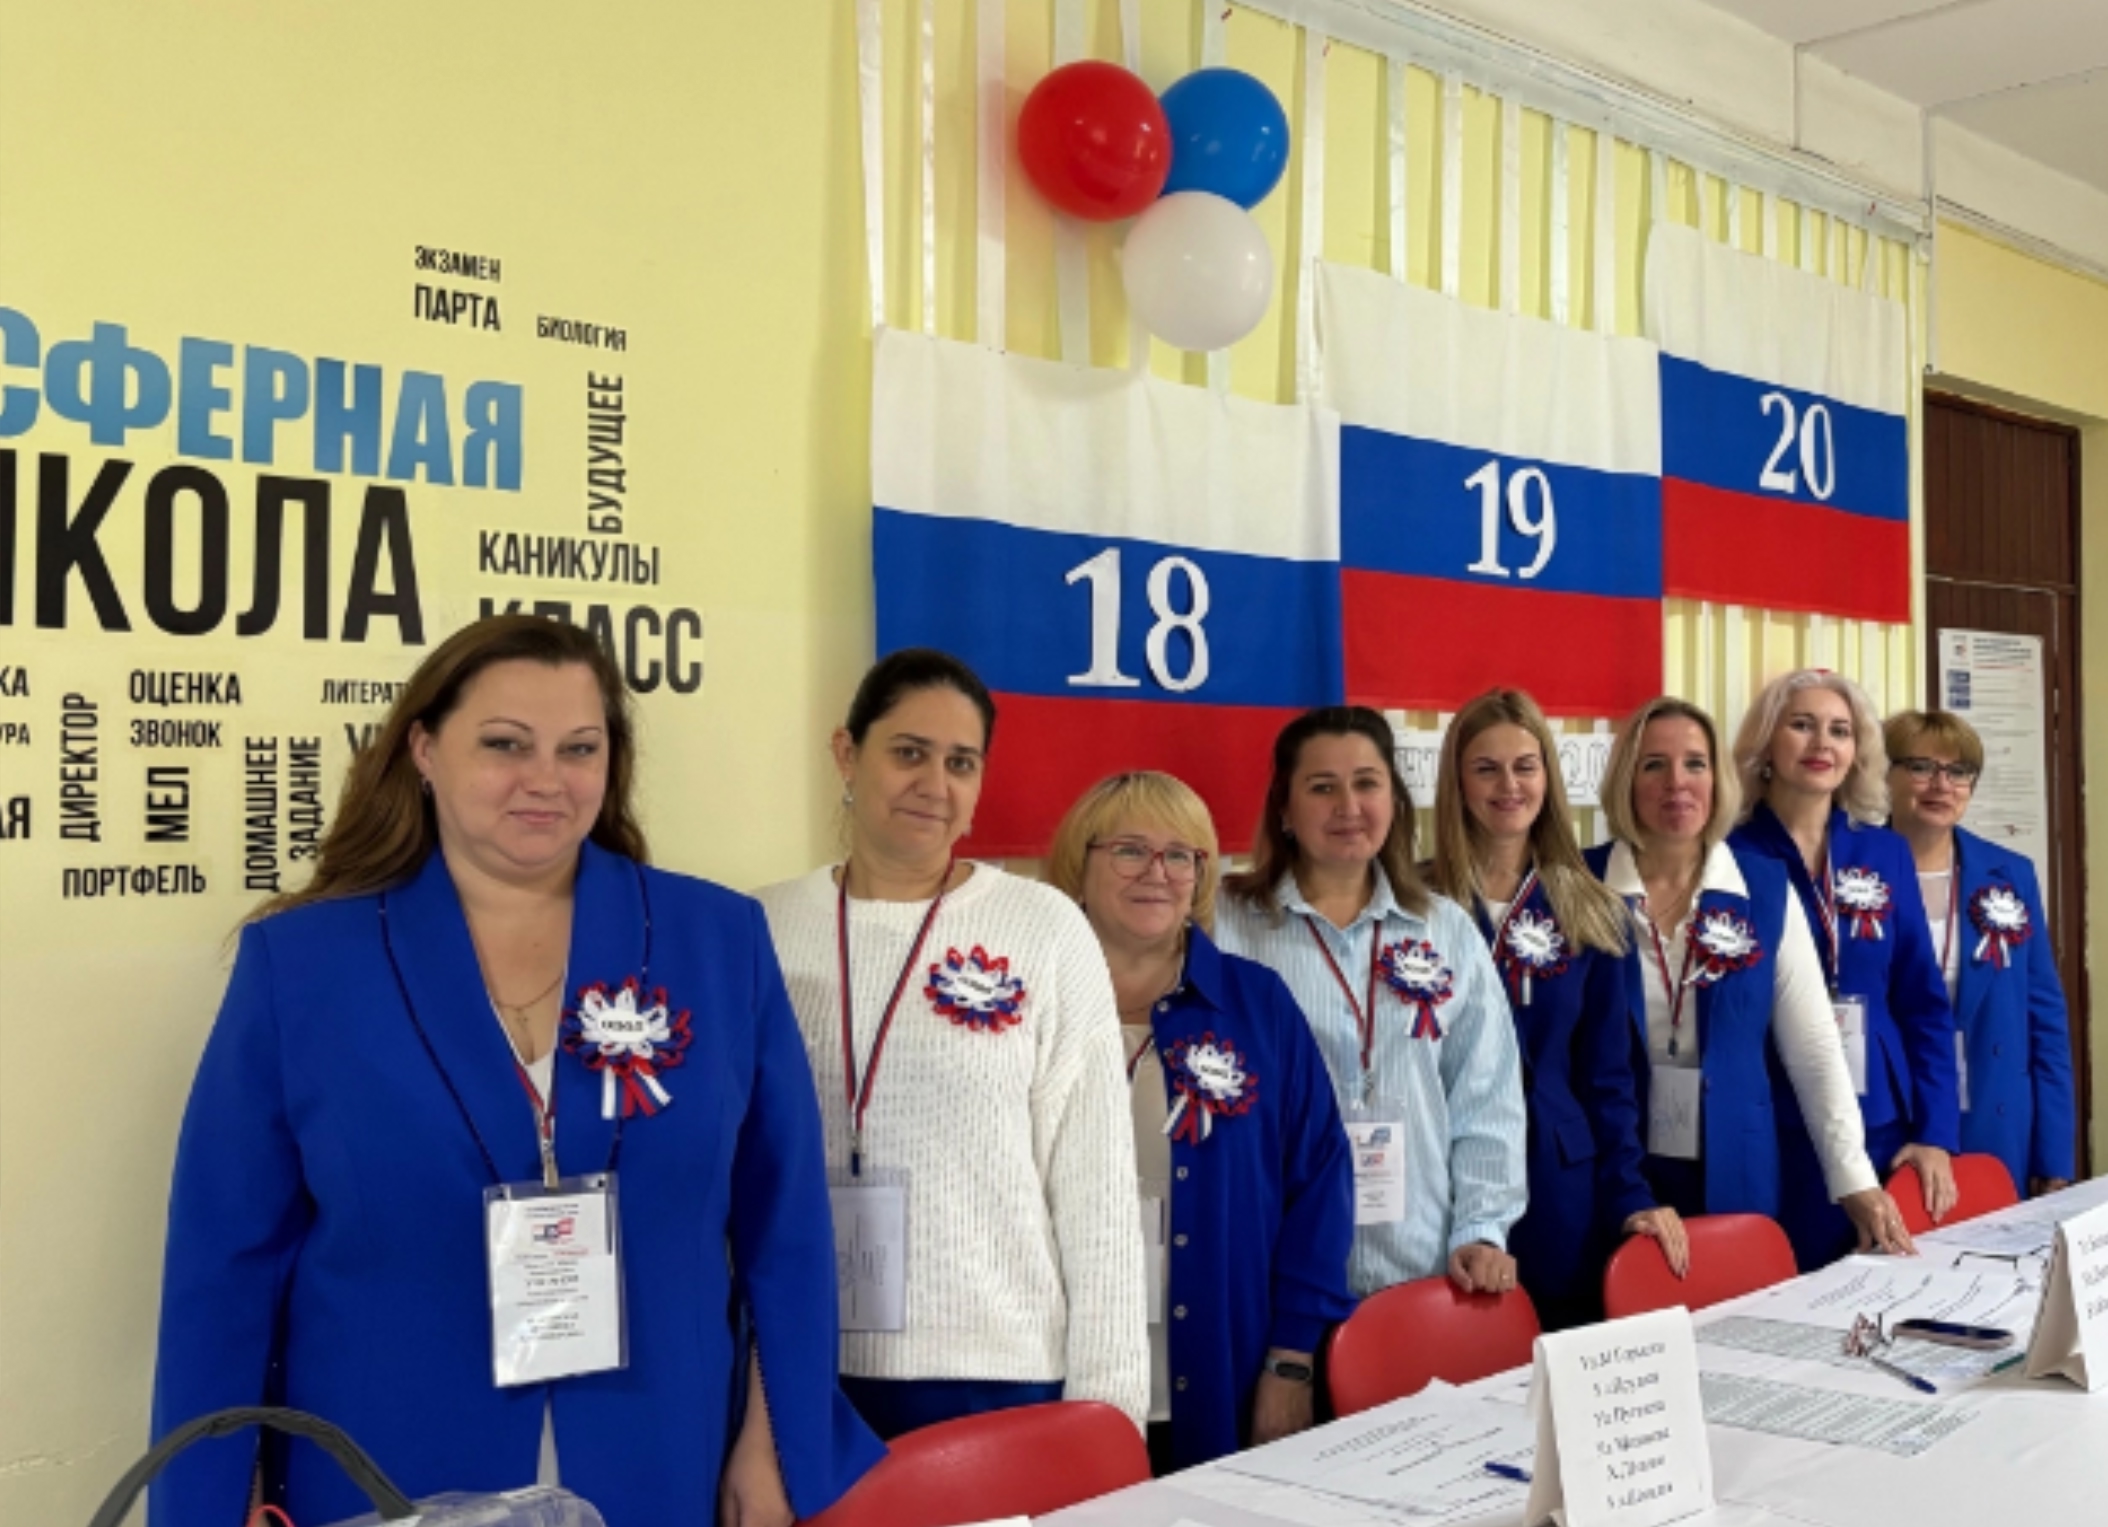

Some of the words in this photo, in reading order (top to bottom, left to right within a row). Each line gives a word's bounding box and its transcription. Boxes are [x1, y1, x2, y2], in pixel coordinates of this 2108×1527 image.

[414, 244, 501, 283] ЭКЗАМЕН
[414, 283, 501, 331] ПАРТА
[537, 315, 627, 352] БИОЛОГИЯ
[587, 372, 625, 534] БУДУЩЕЕ
[1758, 391, 1836, 501] 20
[0, 448, 426, 646] КОЛА
[479, 530, 660, 586] КАНИКУЛЫ
[1463, 460, 1558, 580] 19
[479, 597, 702, 694] АСС
[1064, 547, 1211, 694] 18
[129, 669, 242, 708] ОЦЕНКА
[0, 722, 30, 746] РА
[60, 692, 101, 843] ДИРЕКТОР
[129, 718, 222, 749] ЗВОНОК
[0, 795, 31, 840] Я
[145, 766, 190, 843] МЕЛ
[244, 736, 280, 894] ДОМАШНЕЕ
[288, 736, 324, 861] ЗАДАНИЕ
[62, 864, 207, 899] ПОРТФЕЛЬ
